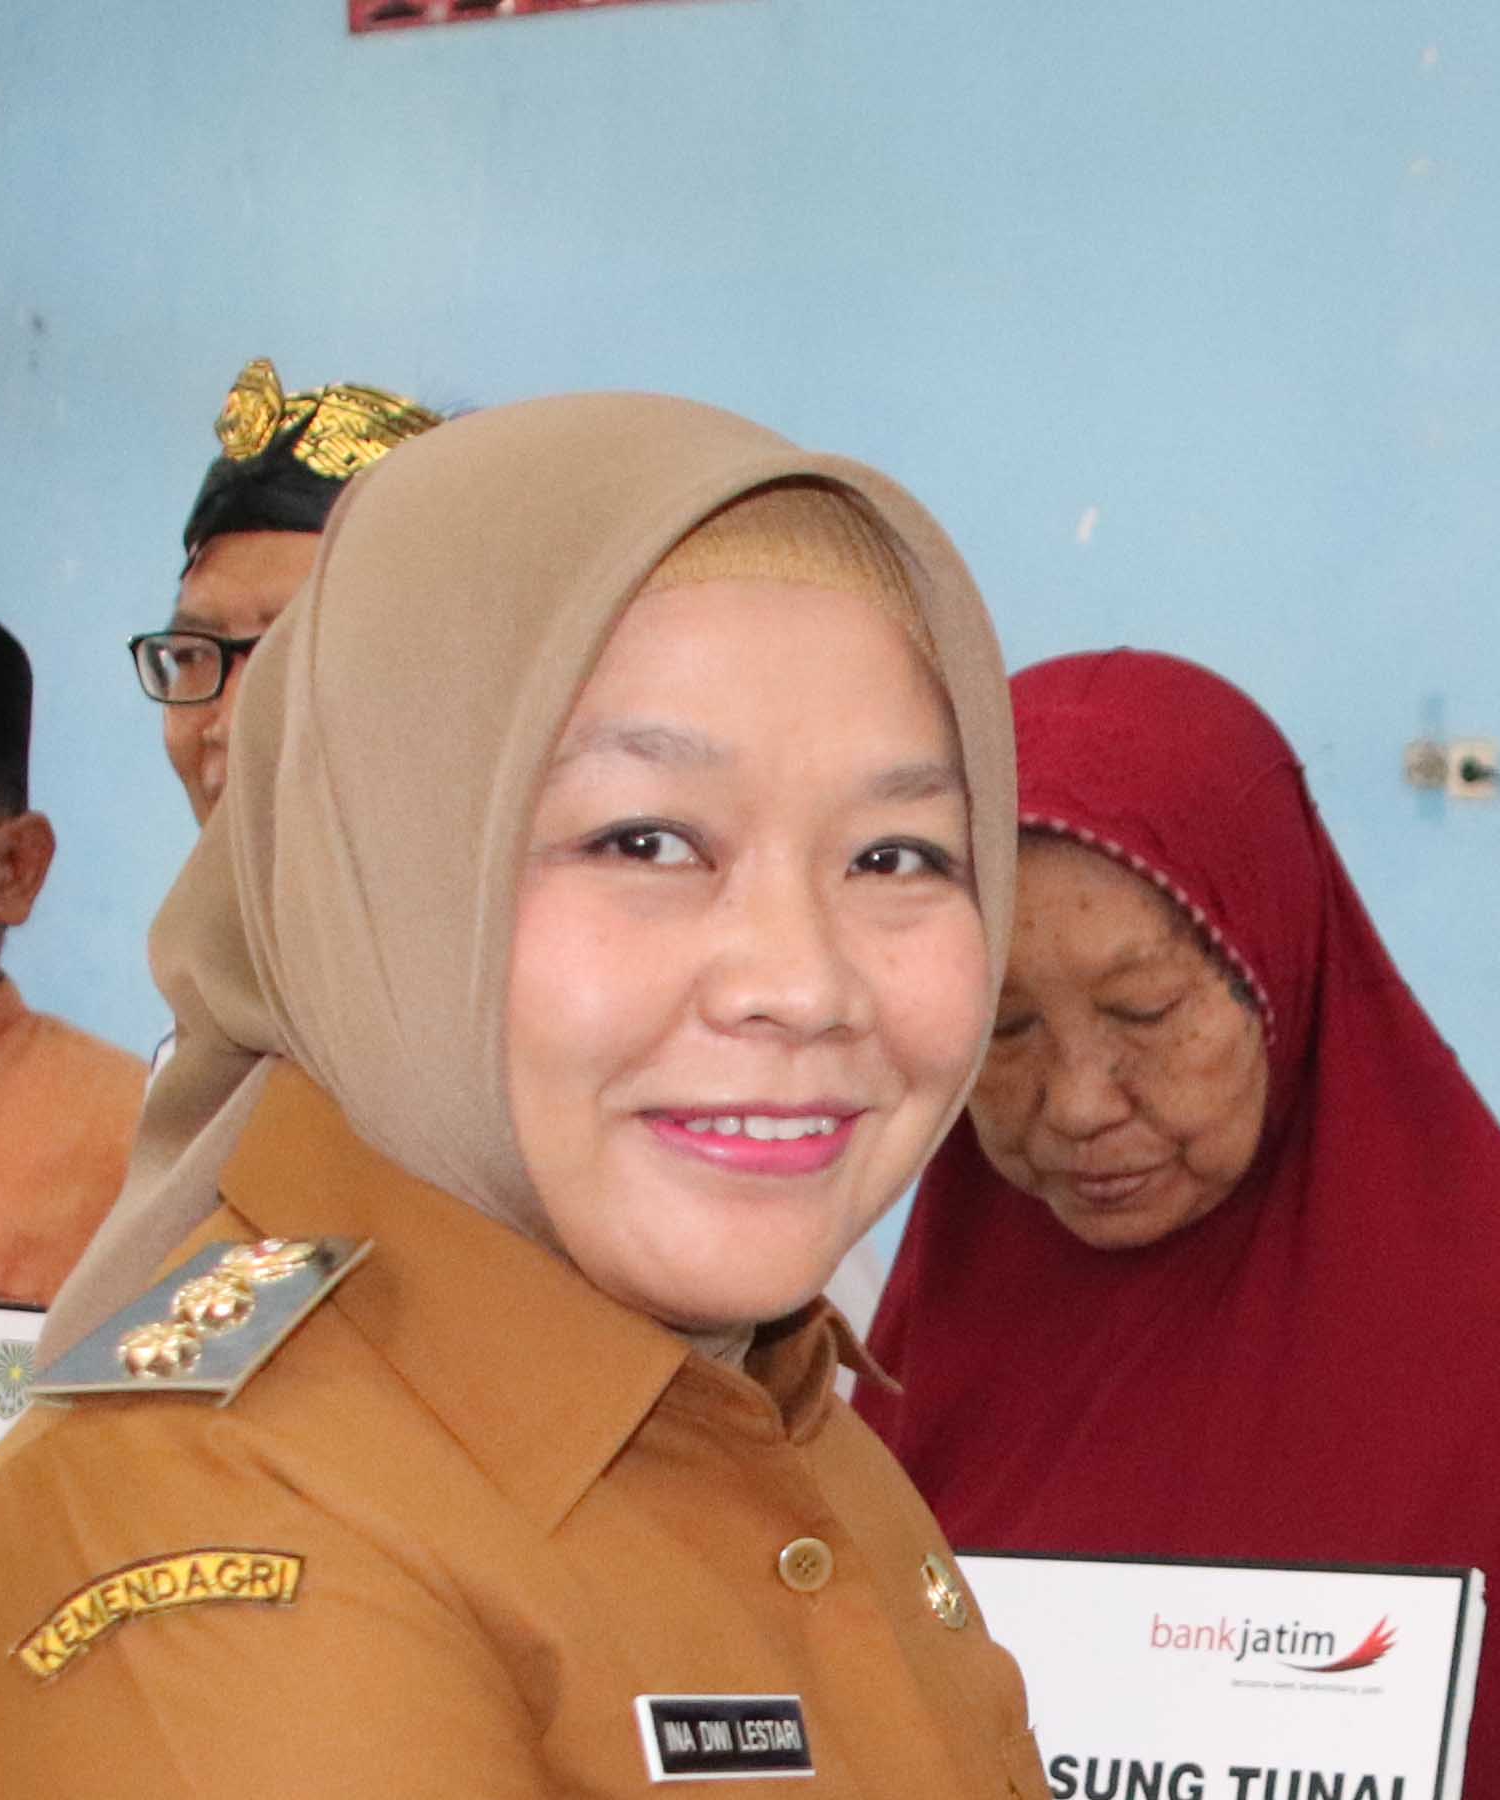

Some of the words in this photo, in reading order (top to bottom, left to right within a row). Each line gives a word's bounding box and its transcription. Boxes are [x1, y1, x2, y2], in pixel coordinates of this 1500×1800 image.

[25, 1557, 290, 1664] KEMENDAGRI
[1149, 1612, 1336, 1662] bankjatim
[663, 1720, 698, 1753] INA
[699, 1720, 734, 1752] DWI
[736, 1719, 804, 1753] LESTARI
